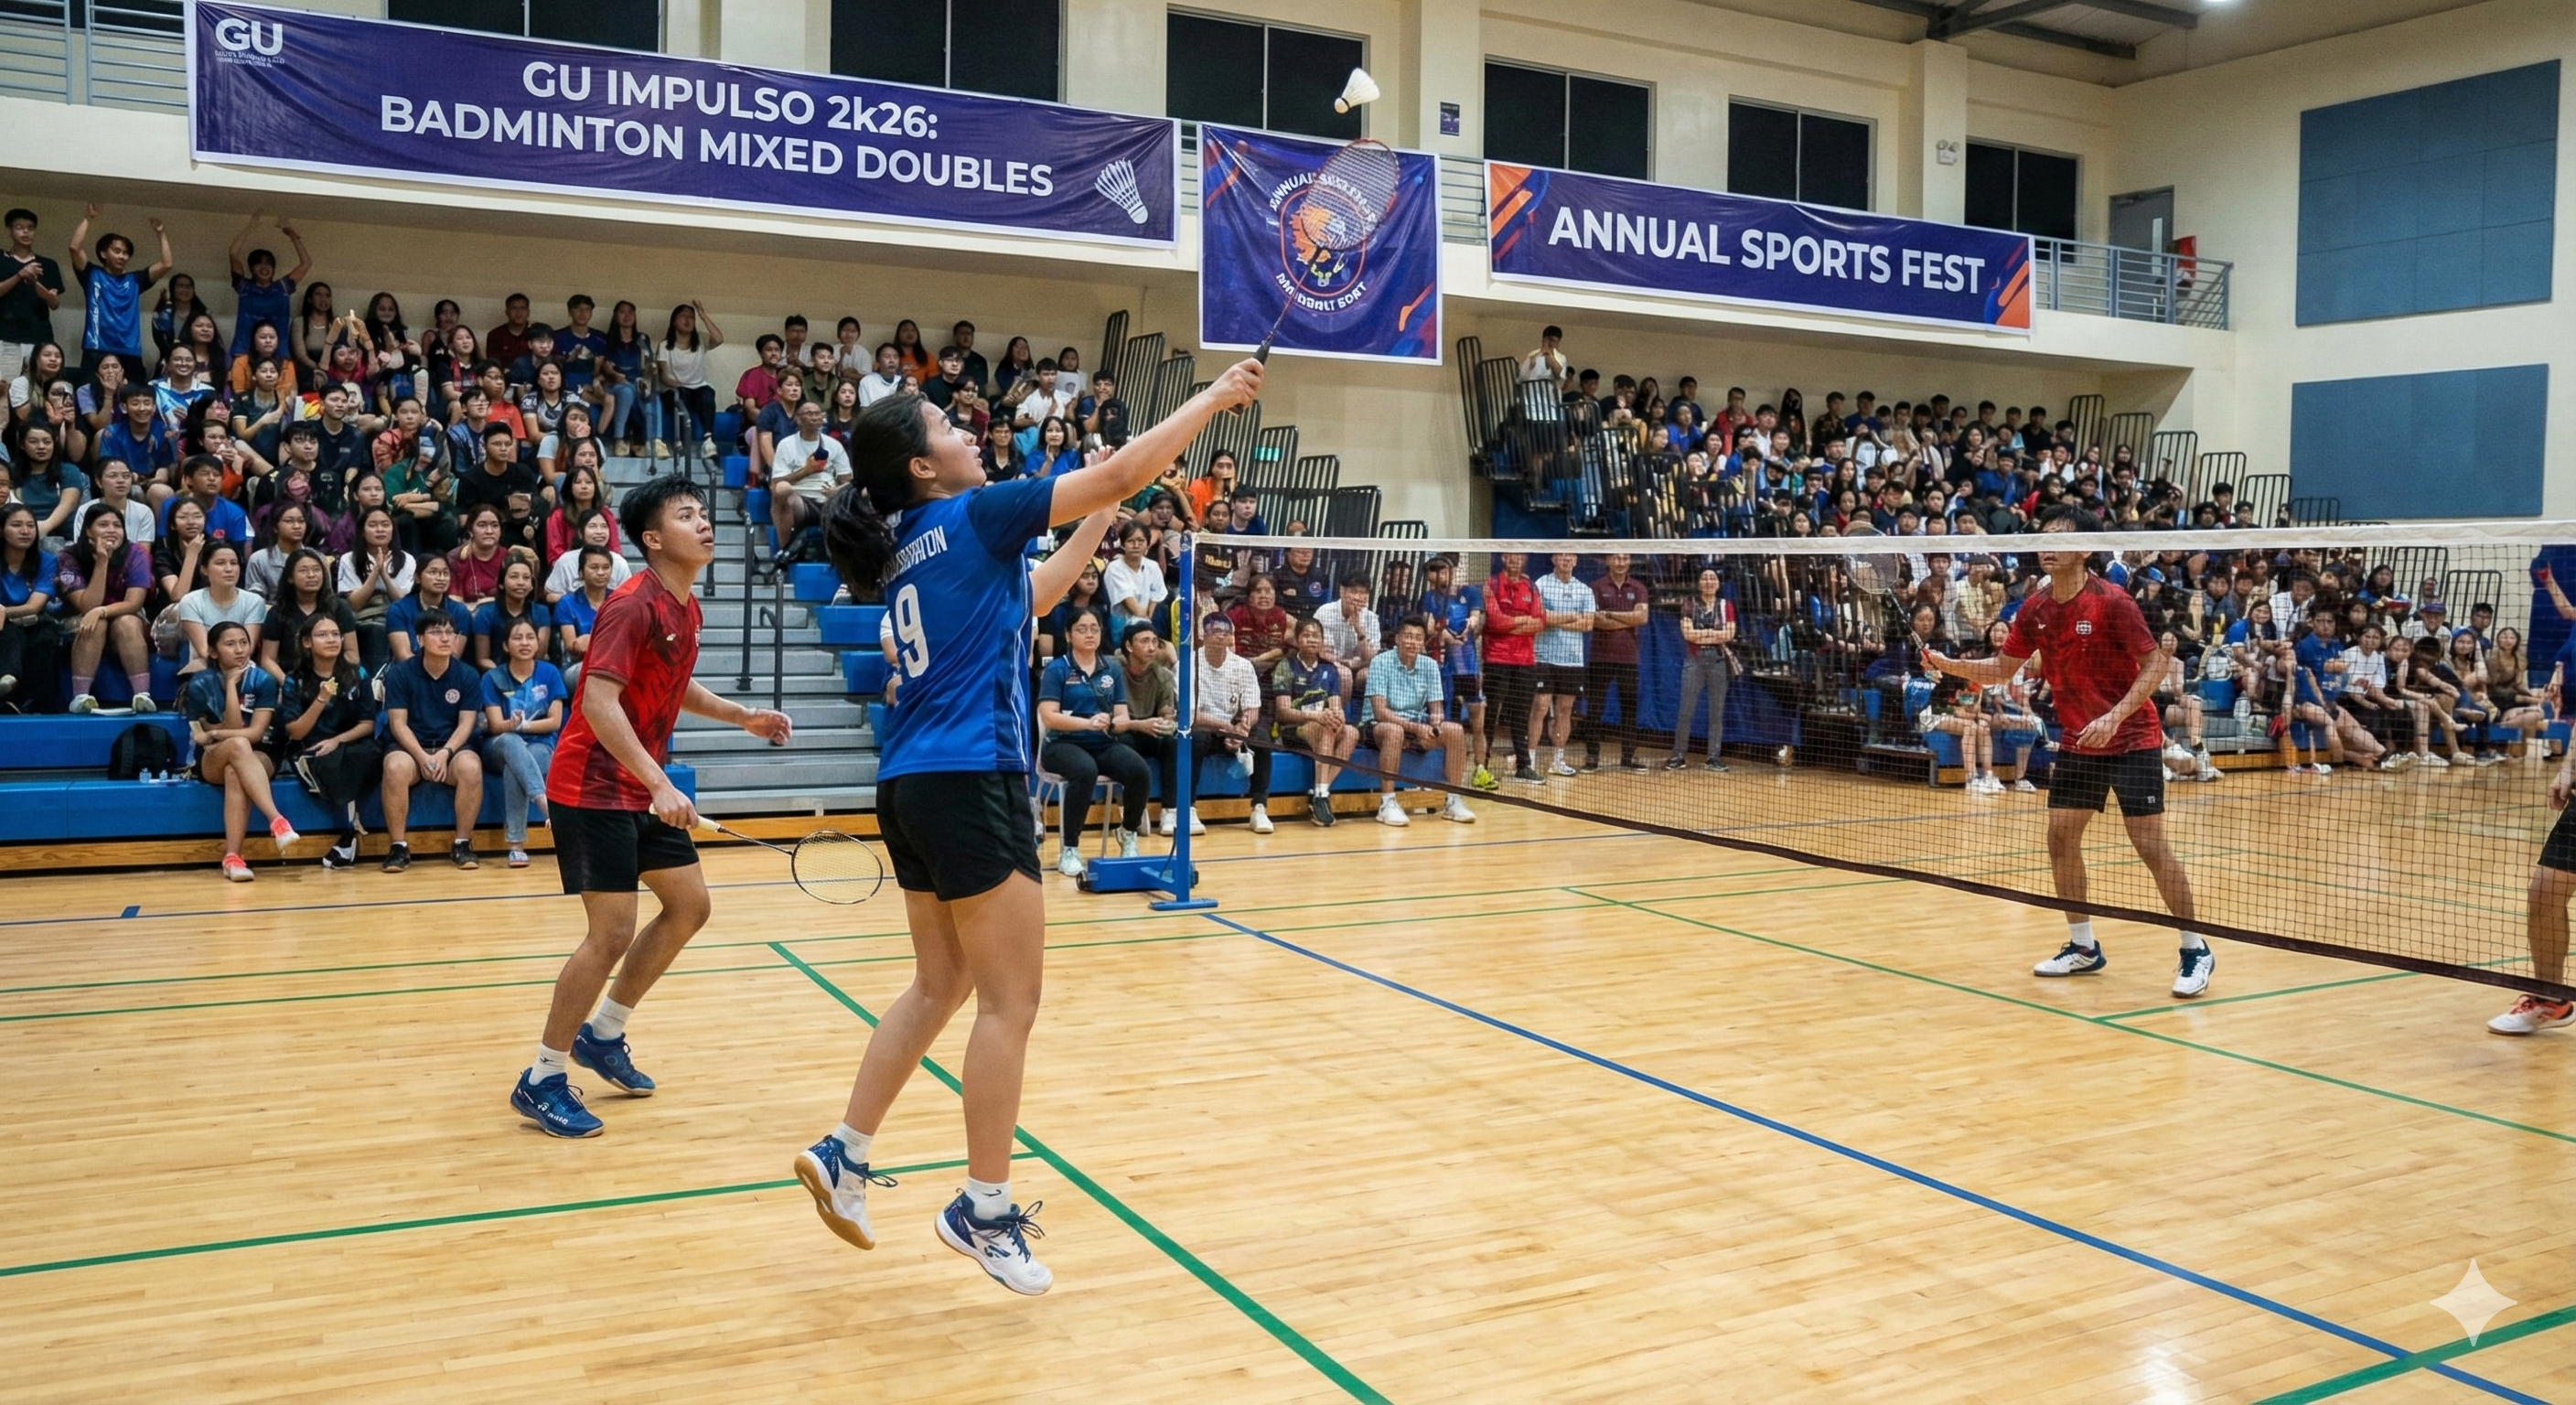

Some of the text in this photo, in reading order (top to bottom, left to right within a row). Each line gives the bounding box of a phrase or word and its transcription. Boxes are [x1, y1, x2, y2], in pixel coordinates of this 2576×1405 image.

[215, 18, 284, 56] GU
[523, 61, 938, 140] GU IMPULSO 2k26:
[381, 94, 1054, 197] BADMINTON MIXED DOUBLES
[1548, 206, 1985, 294] ANNUAL SPORTS FEST
[896, 584, 929, 679] 9
